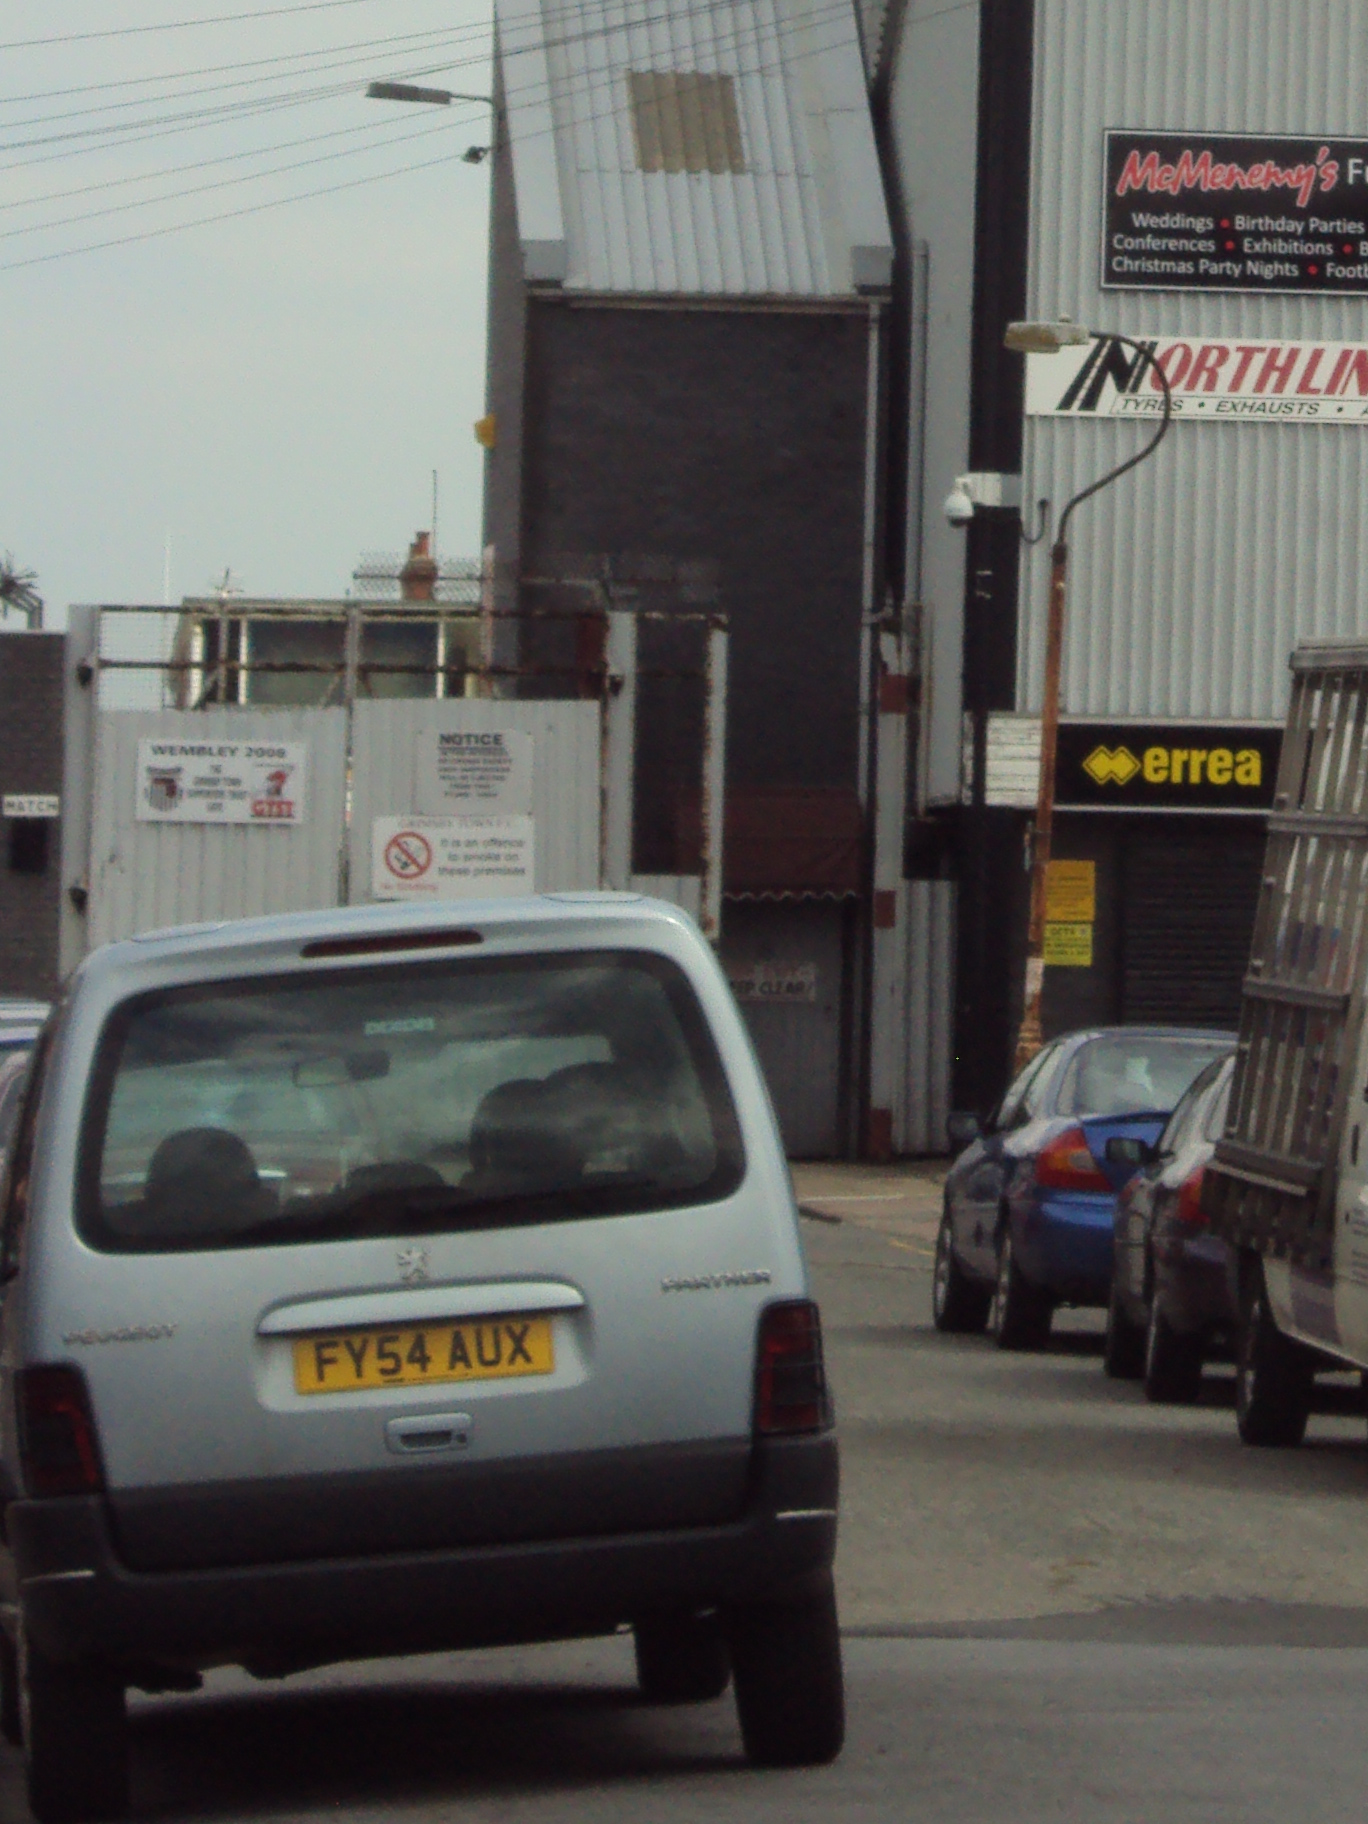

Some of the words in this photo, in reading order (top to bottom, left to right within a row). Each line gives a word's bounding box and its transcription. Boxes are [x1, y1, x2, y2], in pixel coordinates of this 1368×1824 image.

[1115, 145, 1340, 208] McMenemy's
[1131, 212, 1214, 232] Weddings
[1234, 214, 1304, 235] Birthday
[1309, 217, 1366, 235] Parties
[1112, 234, 1216, 252] Conferences
[1243, 237, 1334, 256] Exhibitions
[1111, 255, 1194, 274] Christmas
[1199, 258, 1243, 278] Party
[1246, 260, 1299, 279] Nights
[1121, 398, 1184, 412] TYRES
[1215, 399, 1320, 415] EXHAUSTS
[438, 733, 503, 746] NOTICE
[151, 745, 239, 758] WEMBLEY
[314, 1331, 431, 1382] FY54
[448, 1324, 533, 1371] AUX
